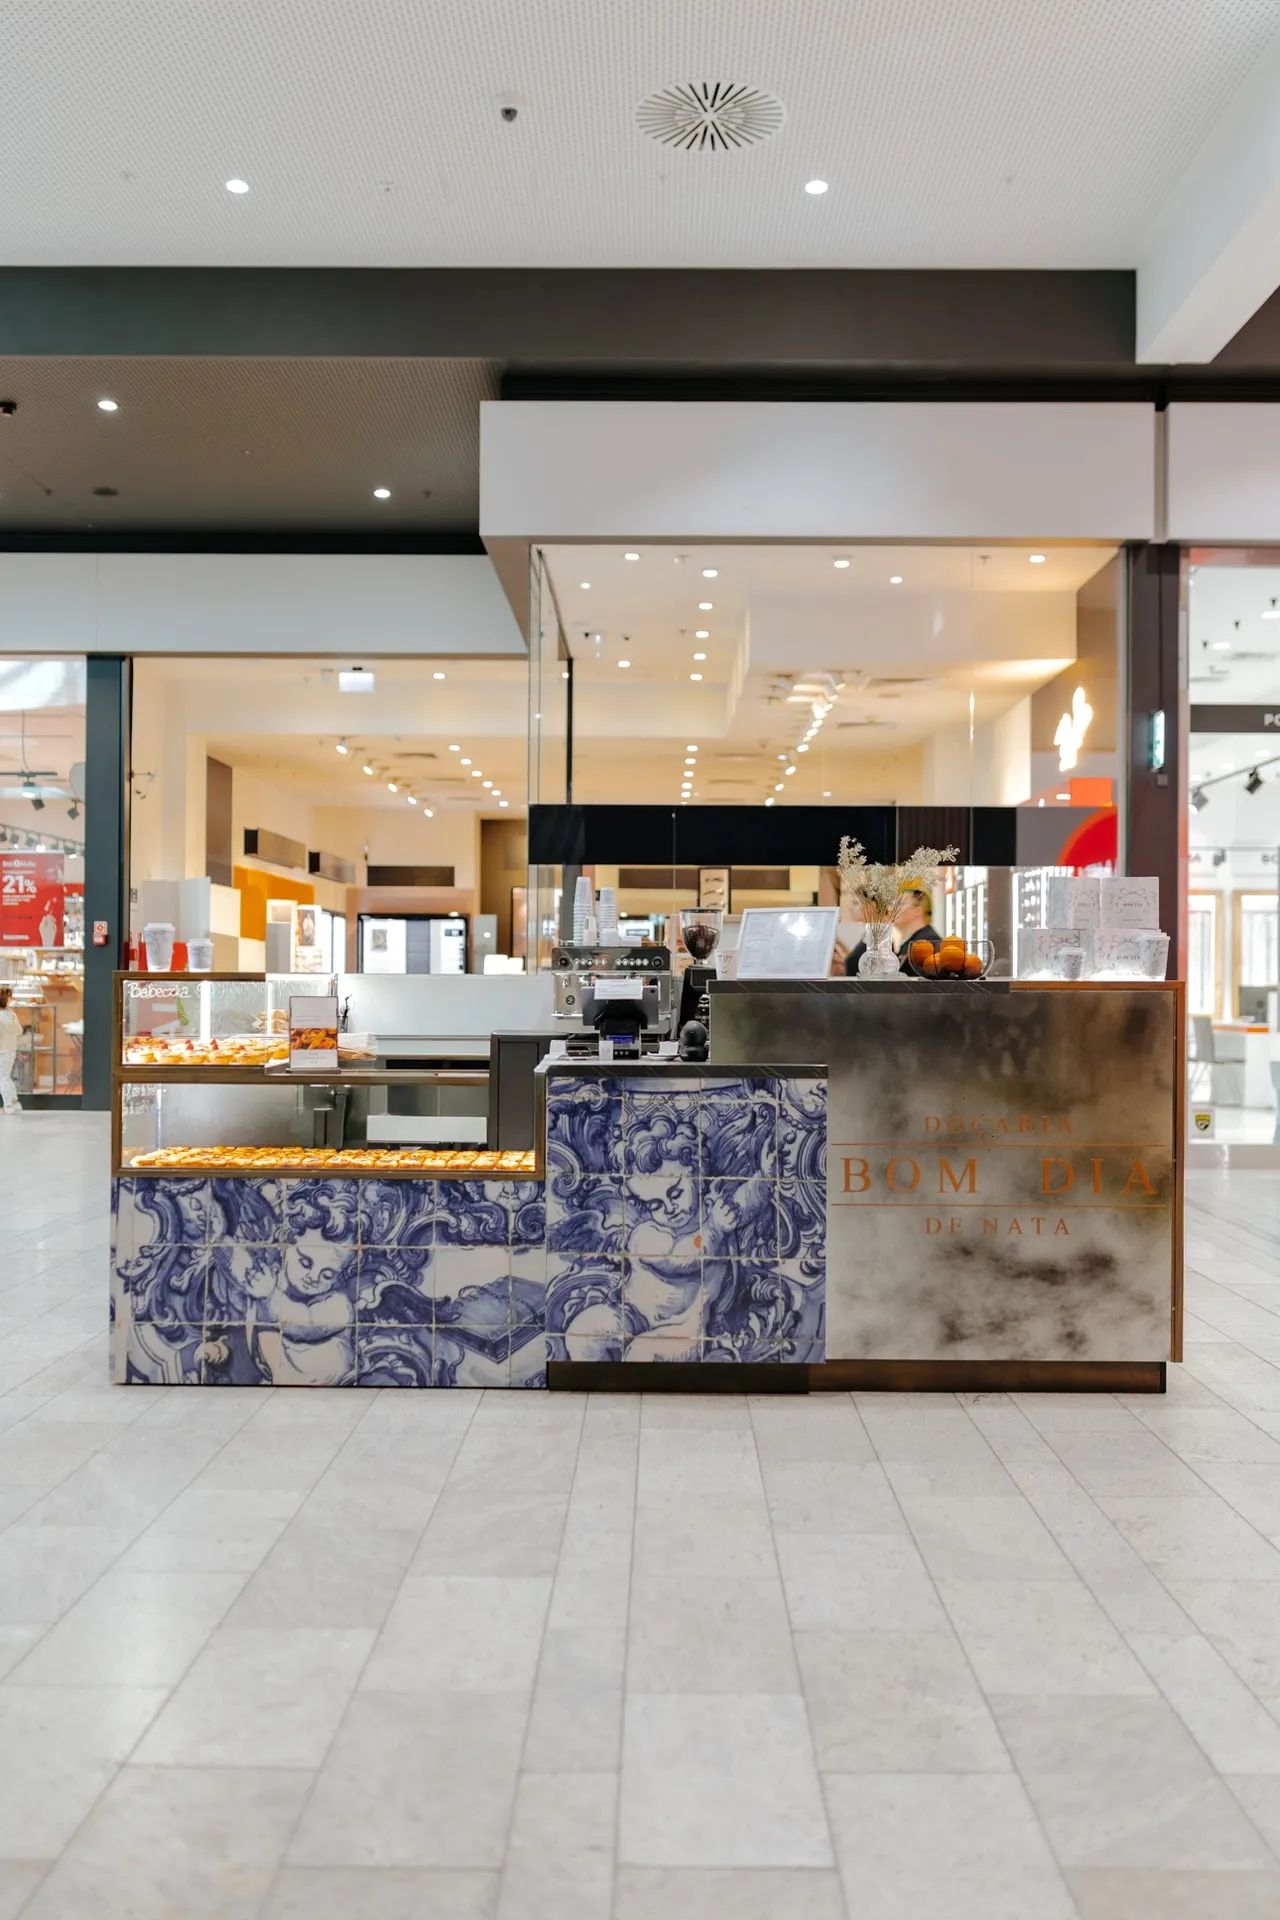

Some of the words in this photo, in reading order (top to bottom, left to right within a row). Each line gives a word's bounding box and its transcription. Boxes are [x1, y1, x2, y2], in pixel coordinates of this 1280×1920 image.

[2, 874, 37, 893] 21%
[924, 1115, 1073, 1137] DOÇARIA
[839, 1156, 980, 1194] BOM
[1038, 1157, 1158, 1195] DIA
[925, 1217, 964, 1235] DE
[982, 1217, 1070, 1235] NATA
